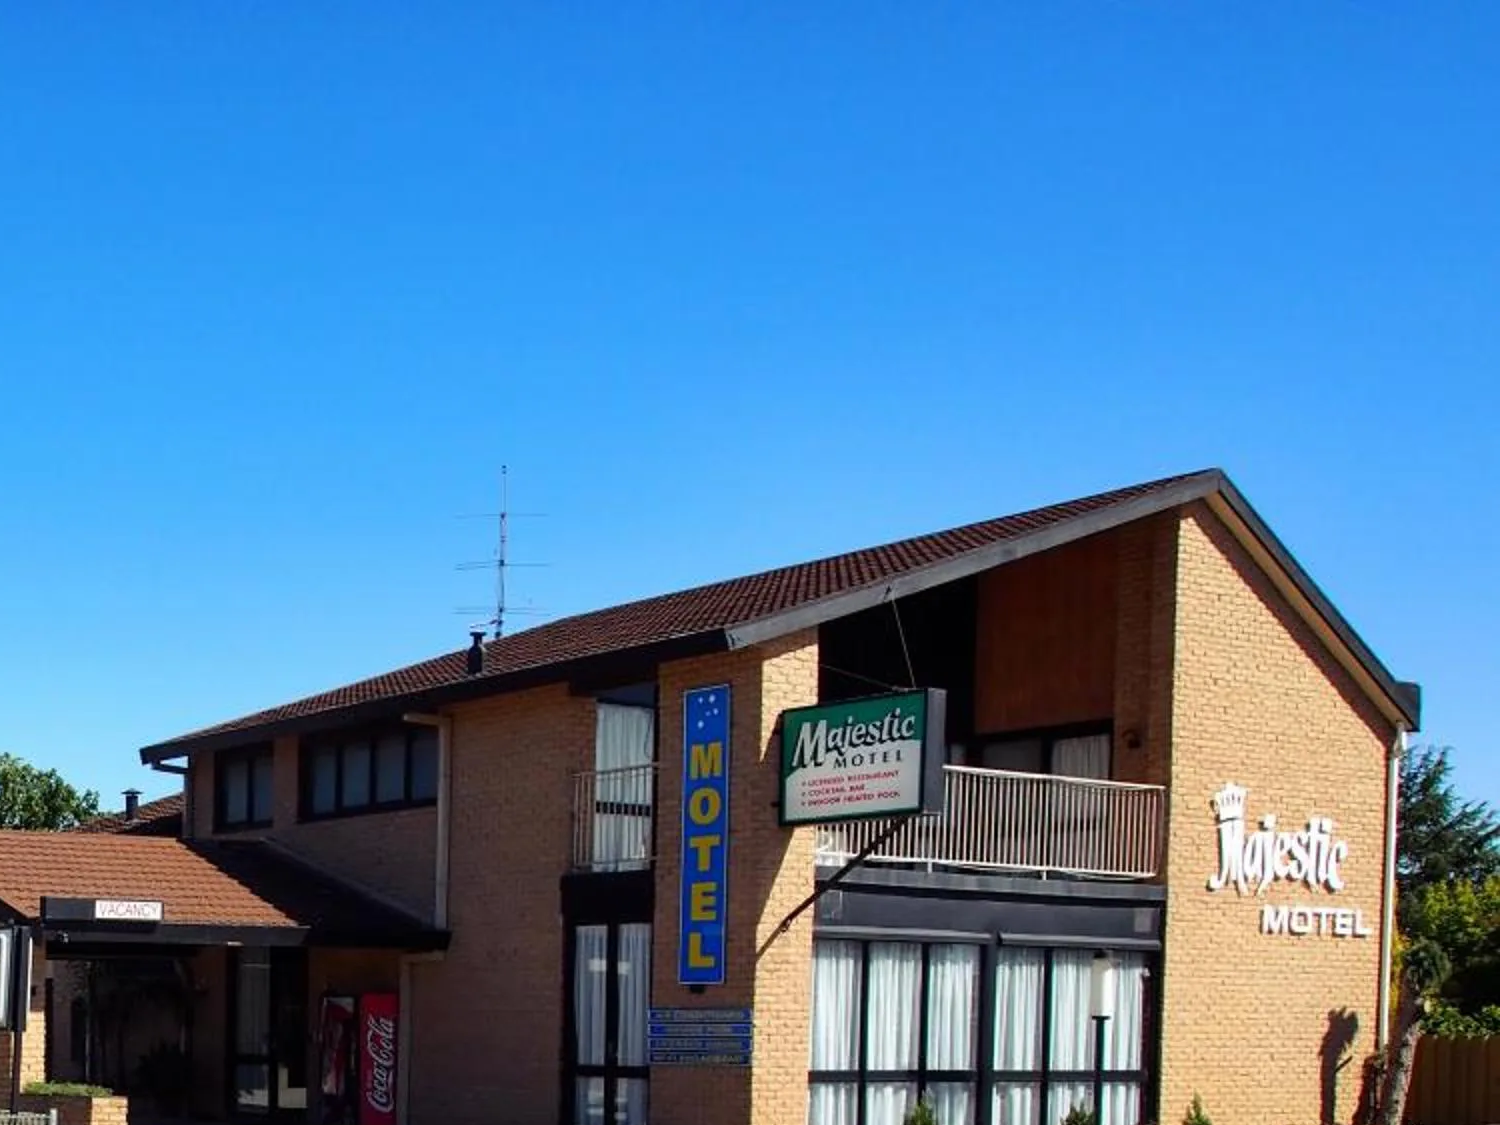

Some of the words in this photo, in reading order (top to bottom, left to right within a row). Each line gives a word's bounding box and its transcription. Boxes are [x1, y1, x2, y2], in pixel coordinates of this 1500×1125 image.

[791, 707, 916, 769] Majestic
[833, 750, 904, 769] MOTEL
[688, 741, 722, 970] MOTEL
[1205, 814, 1349, 898] Majestic
[99, 901, 160, 917] VACANCY
[1259, 904, 1373, 938] MOTEL
